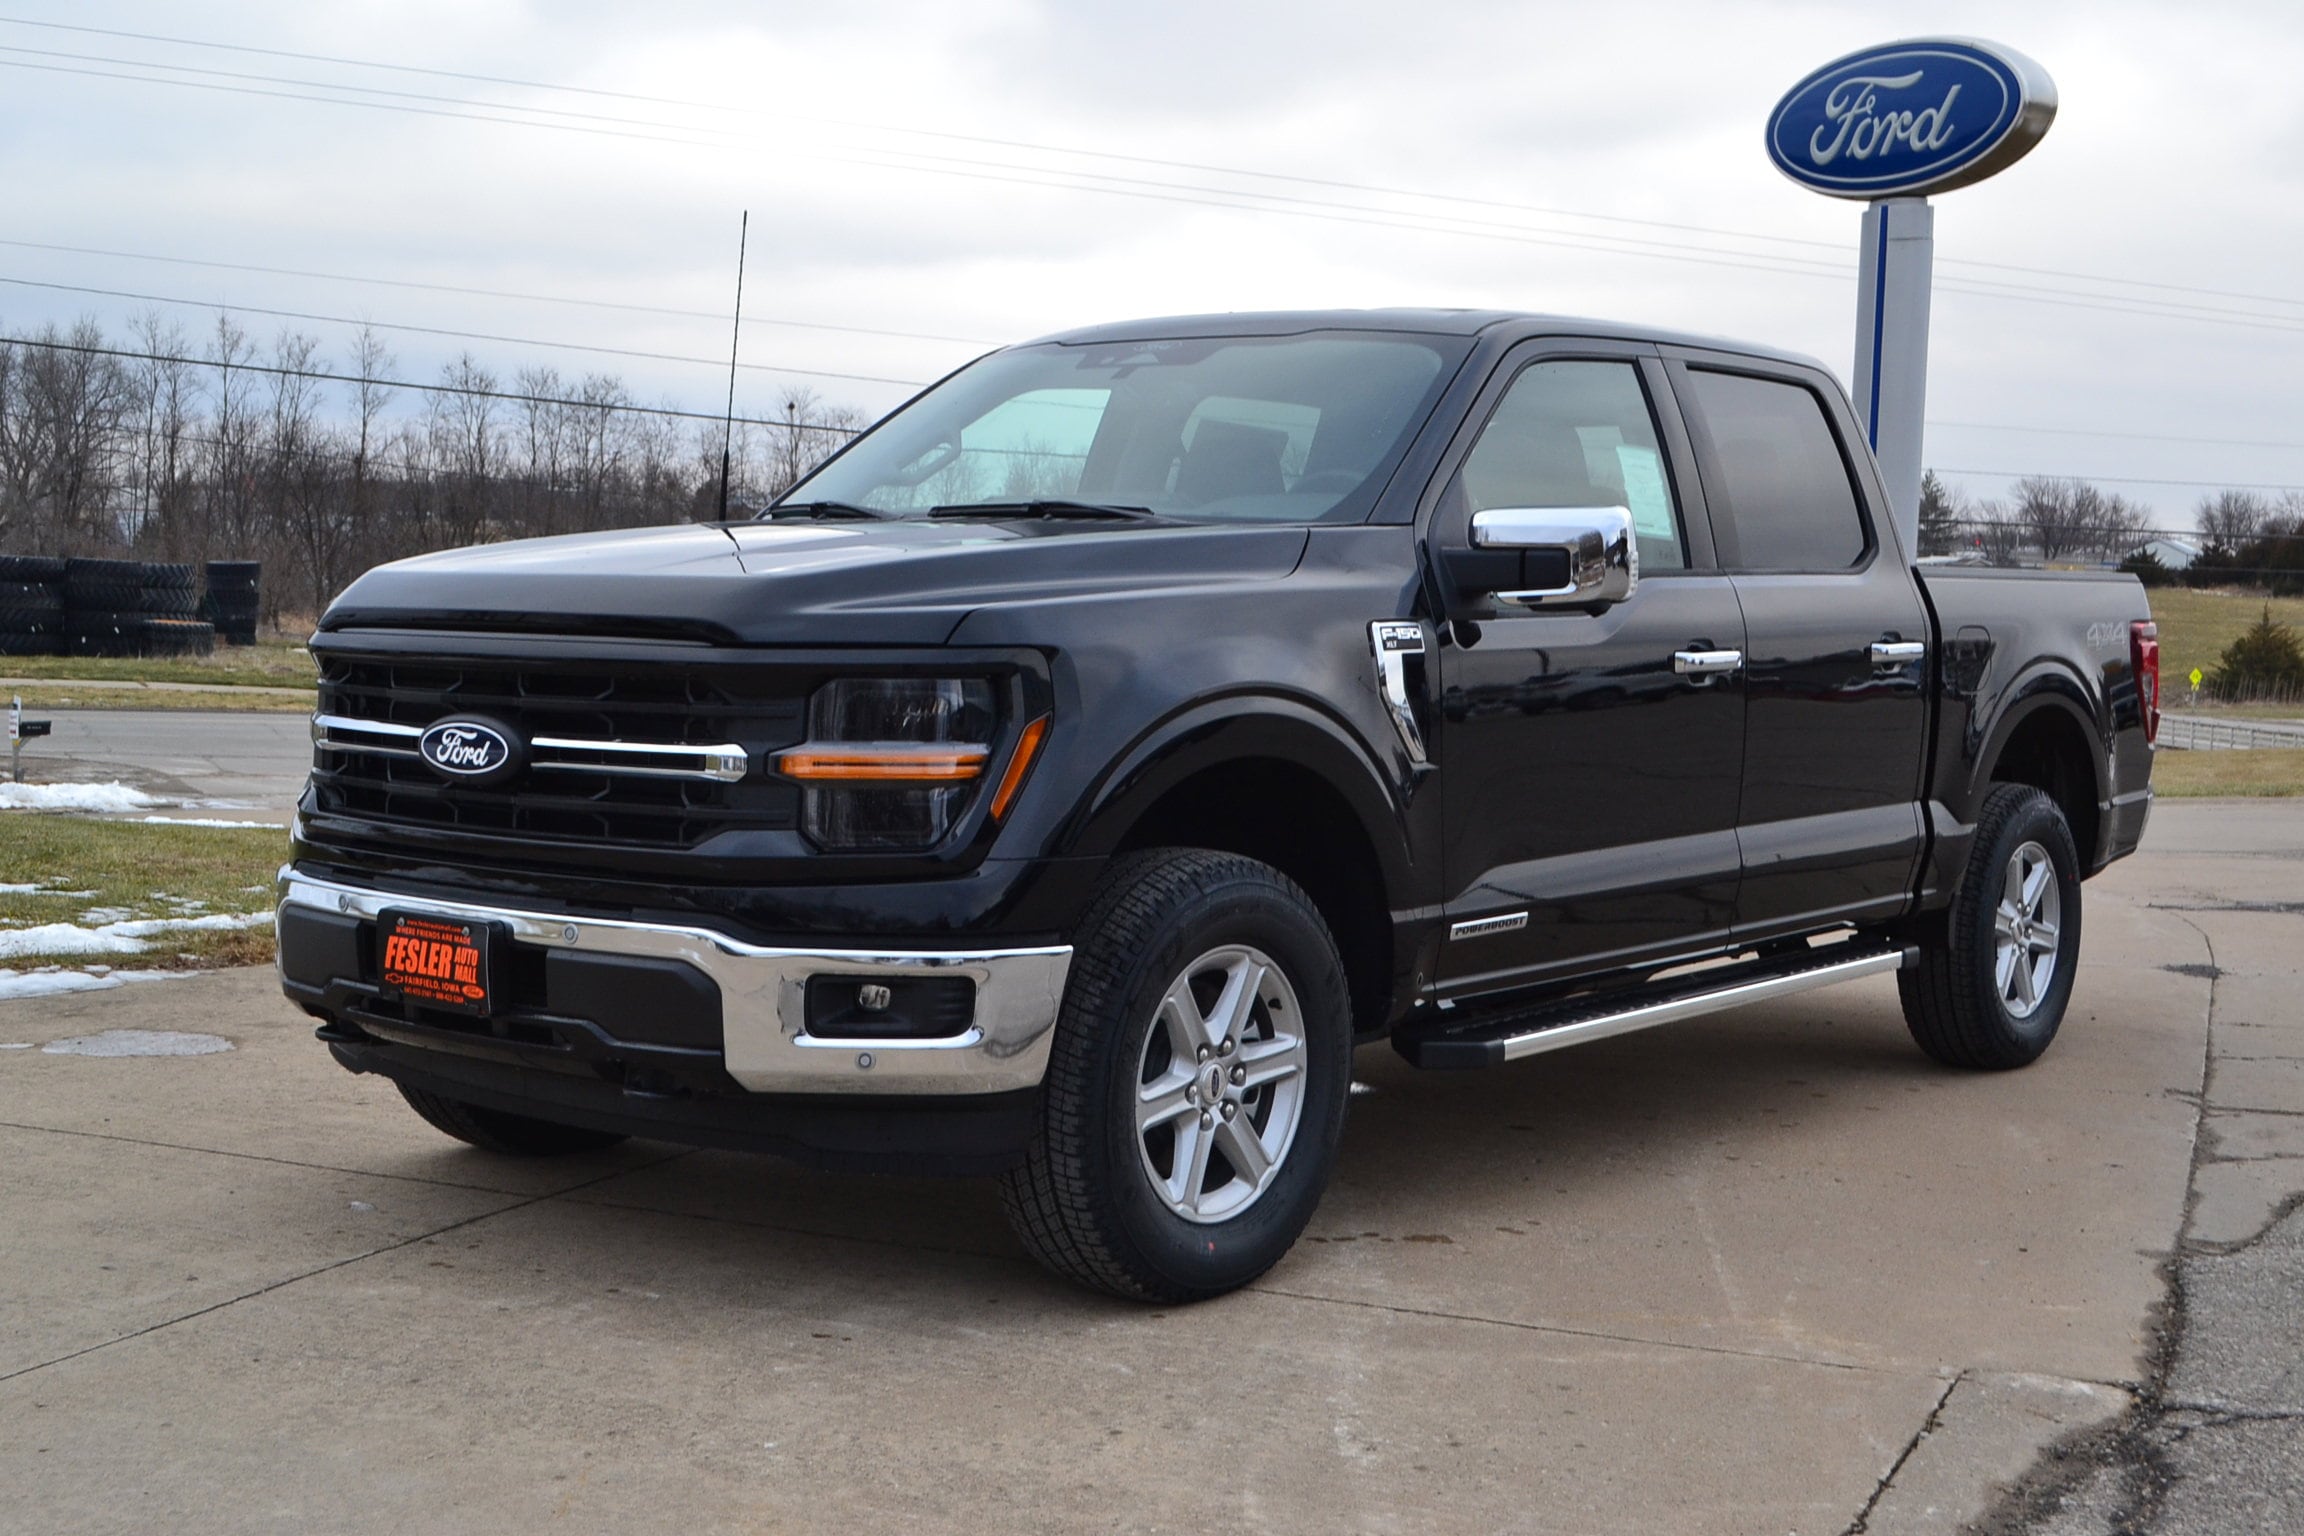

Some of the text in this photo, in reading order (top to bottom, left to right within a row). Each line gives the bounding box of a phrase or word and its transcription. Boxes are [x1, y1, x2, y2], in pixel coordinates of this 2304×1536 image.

[1809, 69, 1962, 167] Ford
[1381, 627, 1420, 640] F-150
[1386, 640, 1397, 649] XLT
[436, 728, 491, 767] Ford
[396, 926, 471, 946] WHERE FRIENDS ARE MADE
[1455, 917, 1525, 936] POWERBOOST
[385, 935, 453, 979] FESLER
[454, 947, 478, 966] AUTO
[455, 965, 477, 984] MALL
[405, 976, 461, 993] FAIRFIELD, IOWA
